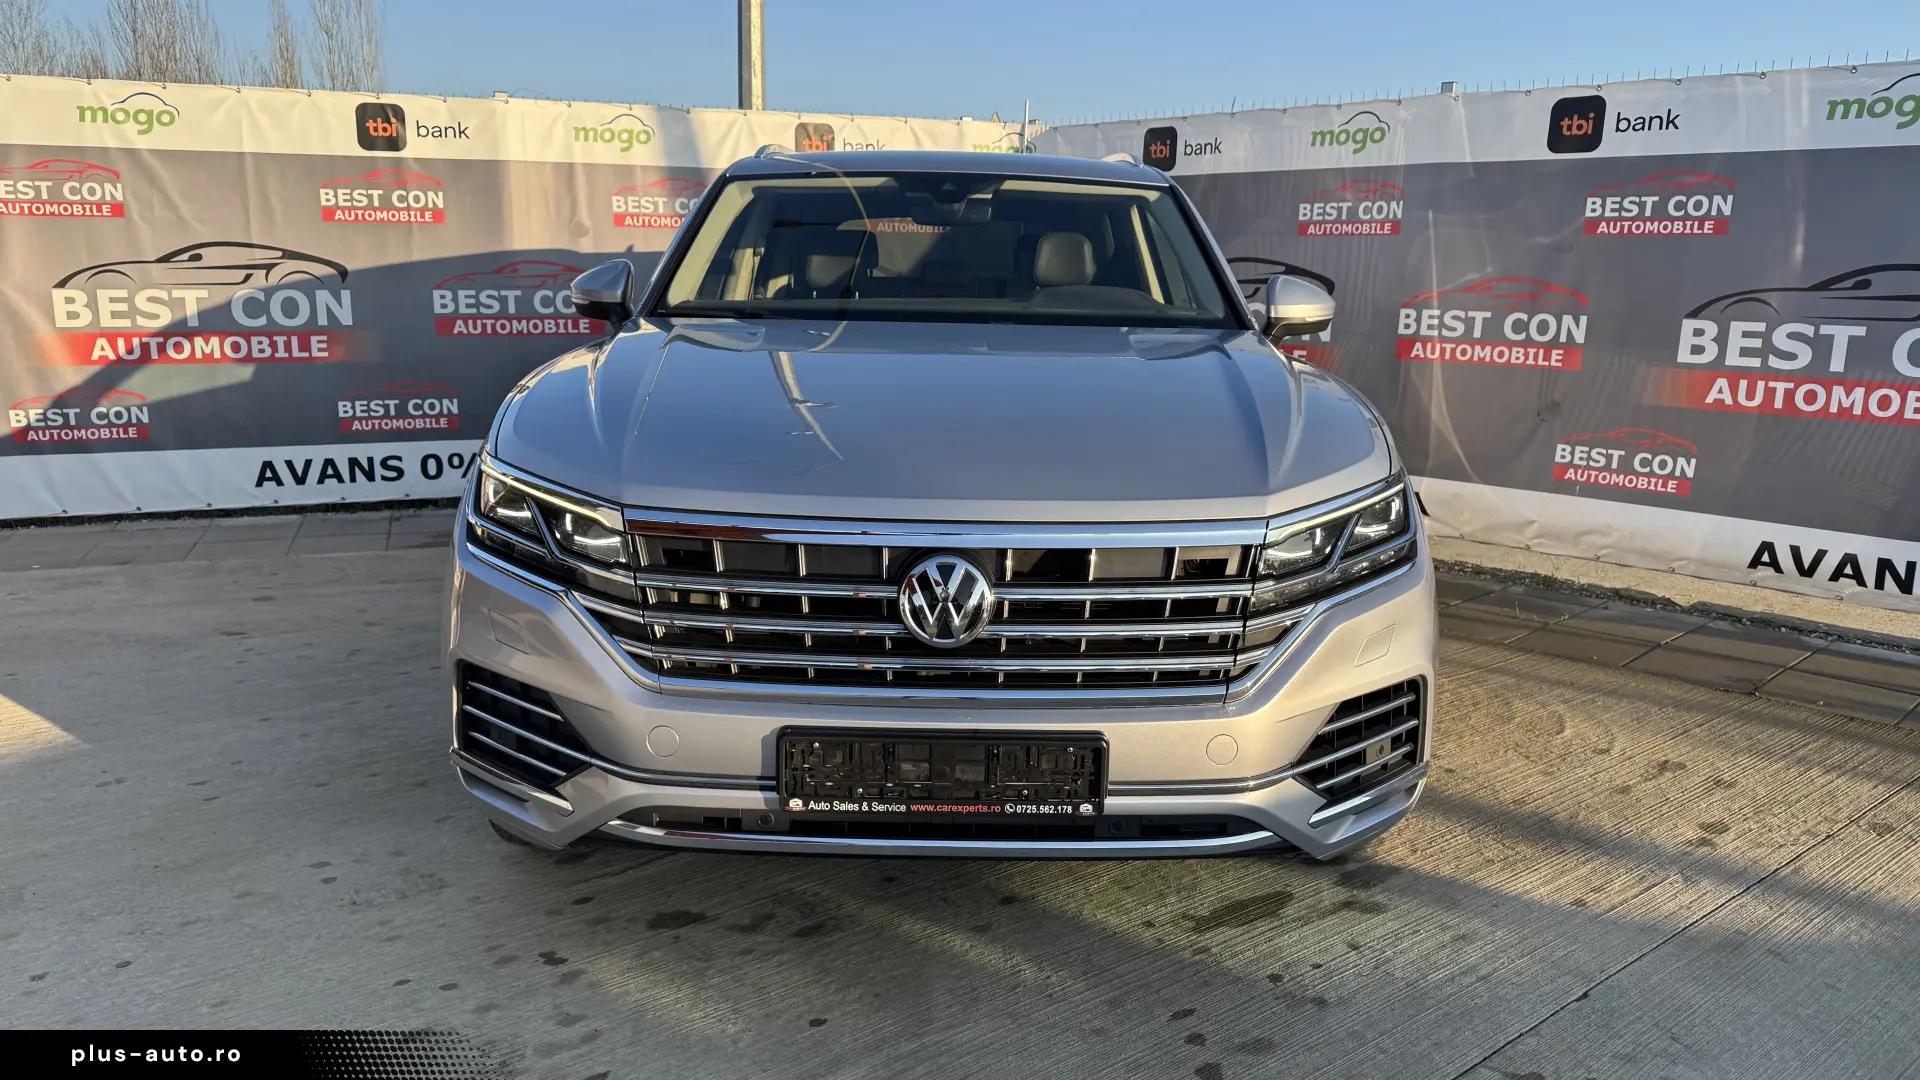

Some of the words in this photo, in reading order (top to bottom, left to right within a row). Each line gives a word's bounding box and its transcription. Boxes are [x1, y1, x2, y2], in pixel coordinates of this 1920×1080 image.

[77, 104, 176, 135] mogo
[1559, 113, 1595, 136] tbi
[1615, 109, 1681, 133] bank
[1826, 94, 1920, 129] mog
[366, 117, 397, 137] tbi
[416, 120, 470, 140] bank
[573, 124, 652, 152] mogo
[1310, 124, 1387, 155] mogo
[1149, 140, 1171, 158] tbi
[1184, 138, 1222, 157] bank
[0, 180, 52, 200] EST
[62, 181, 124, 202] CON
[320, 189, 383, 207] BEST
[391, 190, 444, 209] CON
[334, 210, 434, 222] AUTOMOBILE
[612, 195, 667, 214] BEST
[1298, 201, 1354, 221] BEST
[1358, 200, 1403, 220] CON
[1585, 195, 1660, 218] BEST
[1667, 194, 1734, 217] CON
[624, 215, 683, 227] AUTOMO
[1307, 222, 1392, 236] AUTOMOBILE
[1596, 220, 1715, 235] AUTOMOBILE
[52, 289, 209, 329] BEST
[231, 289, 354, 328] CON
[432, 289, 522, 314] BEST
[533, 289, 576, 314] CO
[453, 319, 590, 335] AUTOMOBILE
[1398, 308, 1491, 339] BEST
[1504, 311, 1588, 344] CON
[91, 335, 329, 361] AUTOMOBILE
[1410, 342, 1564, 368] AUTOMOBILE
[1676, 318, 1867, 373] BEST
[338, 400, 400, 418] BEST
[407, 398, 459, 416] CON
[1704, 377, 1920, 420] AUTOMOB
[8, 406, 81, 429] BEST
[90, 405, 150, 425] CON
[351, 418, 448, 431] AUTOMOBILE
[26, 426, 138, 442] AUTOMOBILE
[255, 455, 405, 488] AVANS
[1554, 443, 1626, 468] BEST
[1633, 452, 1697, 479] CON
[1564, 468, 1678, 494] AUTOMOBILE
[1747, 540, 1918, 596] AVAN
[808, 801, 831, 811] Auto
[832, 801, 859, 812] Sales
[861, 801, 869, 811] &
[871, 802, 907, 812] Service
[910, 802, 1001, 814] www.carexperts.ro
[1016, 805, 1073, 814] 0725.562.178
